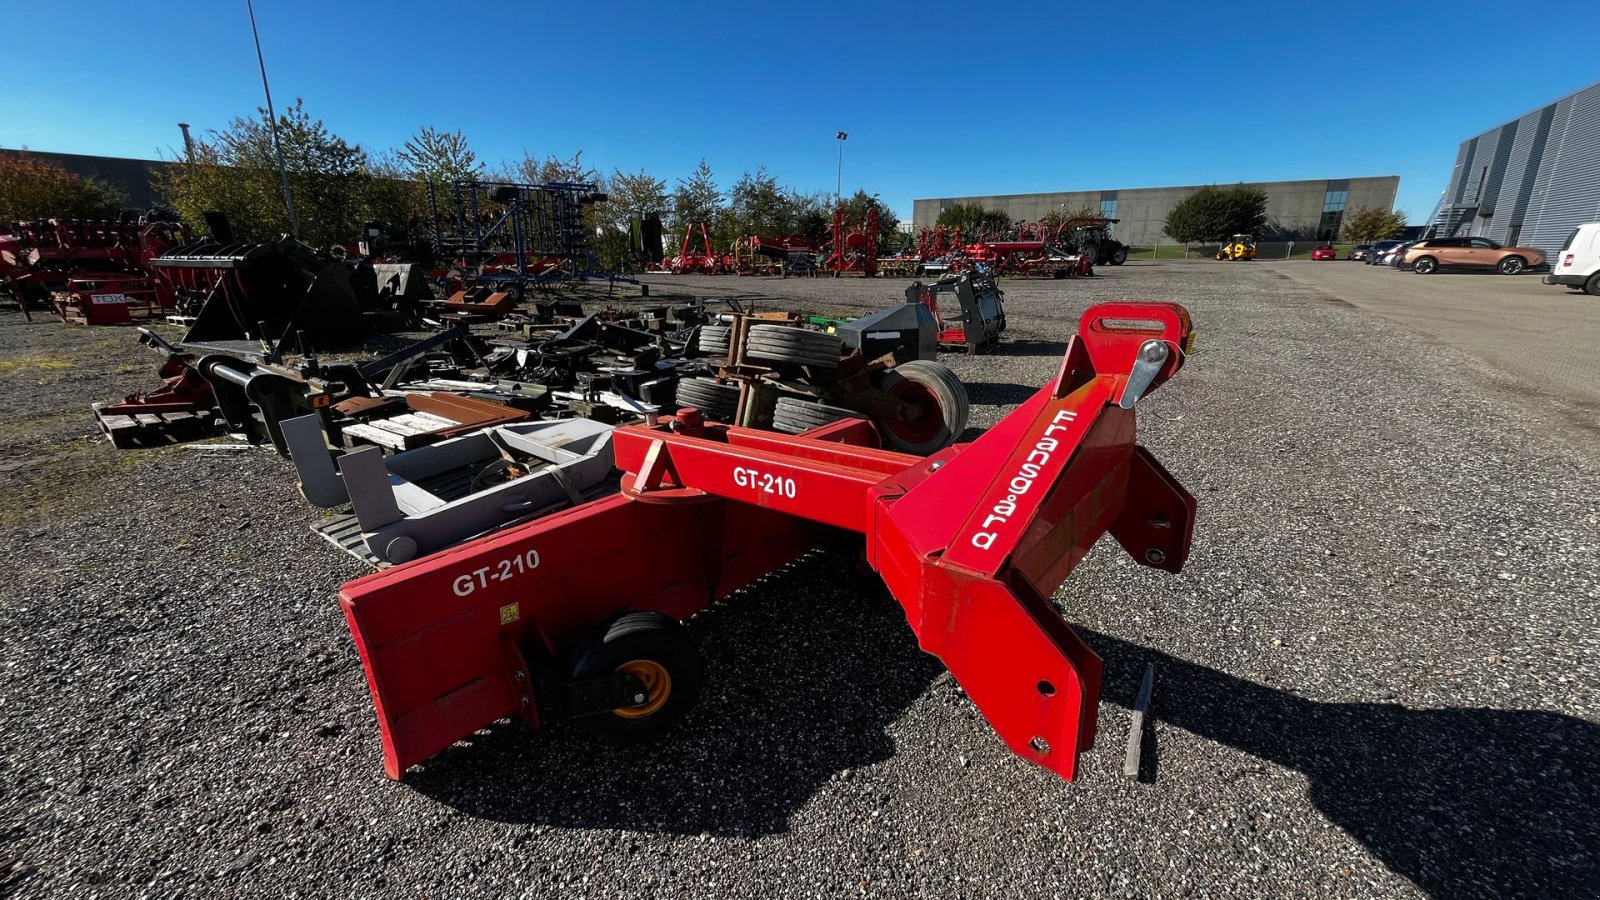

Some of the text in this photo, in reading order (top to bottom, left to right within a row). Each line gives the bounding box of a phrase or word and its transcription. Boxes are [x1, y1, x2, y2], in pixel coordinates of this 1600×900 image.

[733, 466, 796, 499] GT-210
[971, 409, 1078, 550] Fransgård
[452, 549, 540, 597] GT-210
